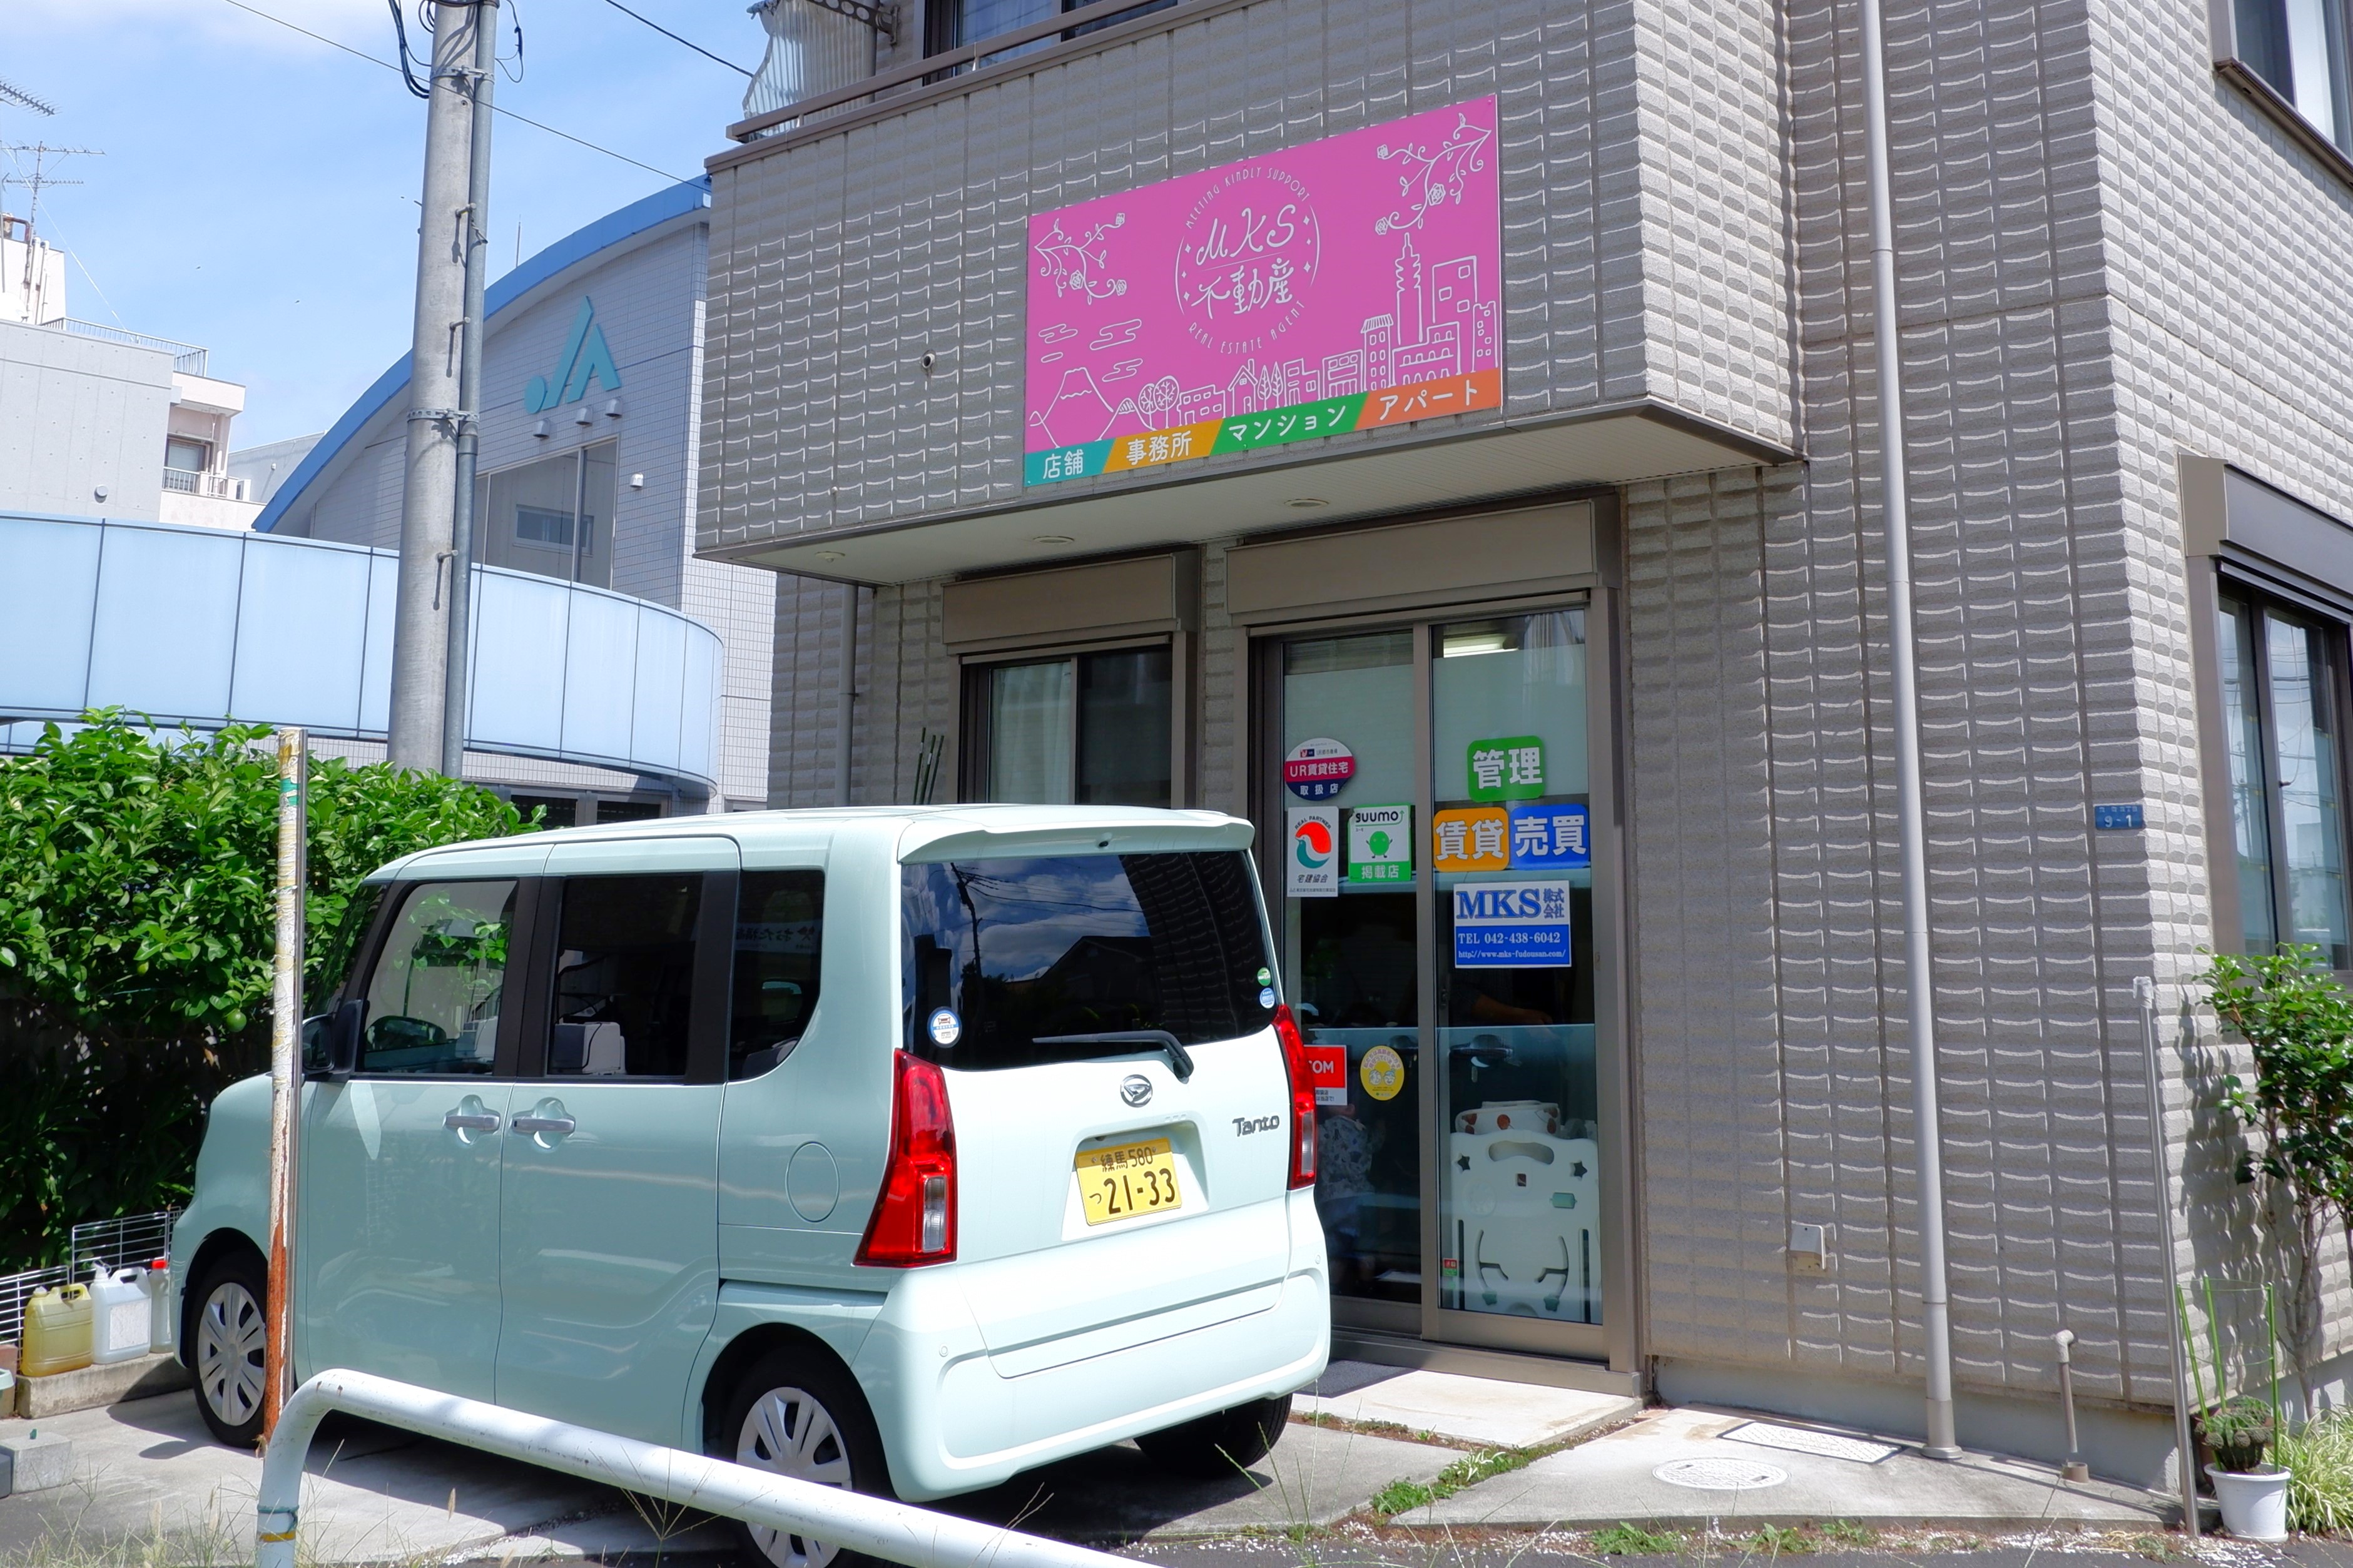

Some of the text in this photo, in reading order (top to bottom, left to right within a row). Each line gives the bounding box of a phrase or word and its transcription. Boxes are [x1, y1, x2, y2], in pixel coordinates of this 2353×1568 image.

[1186, 166, 1309, 229] MEETING KINDLY SUPPORT
[1196, 204, 1296, 265] MKS
[1191, 258, 1294, 320] 不動産
[1189, 300, 1304, 354] REAL ESTATE AGENT
[1042, 379, 1478, 480] 店舗 事務所 マンション アパート
[1289, 761, 1348, 777] UR賃貸住宅
[1473, 747, 1543, 789] 管理
[1300, 783, 1339, 796] 取扱店
[1294, 815, 1332, 829] REAL PARTNER
[1435, 819, 1505, 861] 賃貸
[1513, 814, 1587, 857] 売買
[1361, 865, 1400, 879] 掲載店
[1456, 888, 1542, 919] MKS
[1458, 931, 1560, 944] TEL 042-438-6042
[1458, 949, 1566, 959] http://www.mks-fudousan.com/
[1232, 1115, 1280, 1137] Tanto
[1100, 1146, 1154, 1173] 練馬 580
[1089, 1168, 1176, 1215] つ 21-33
